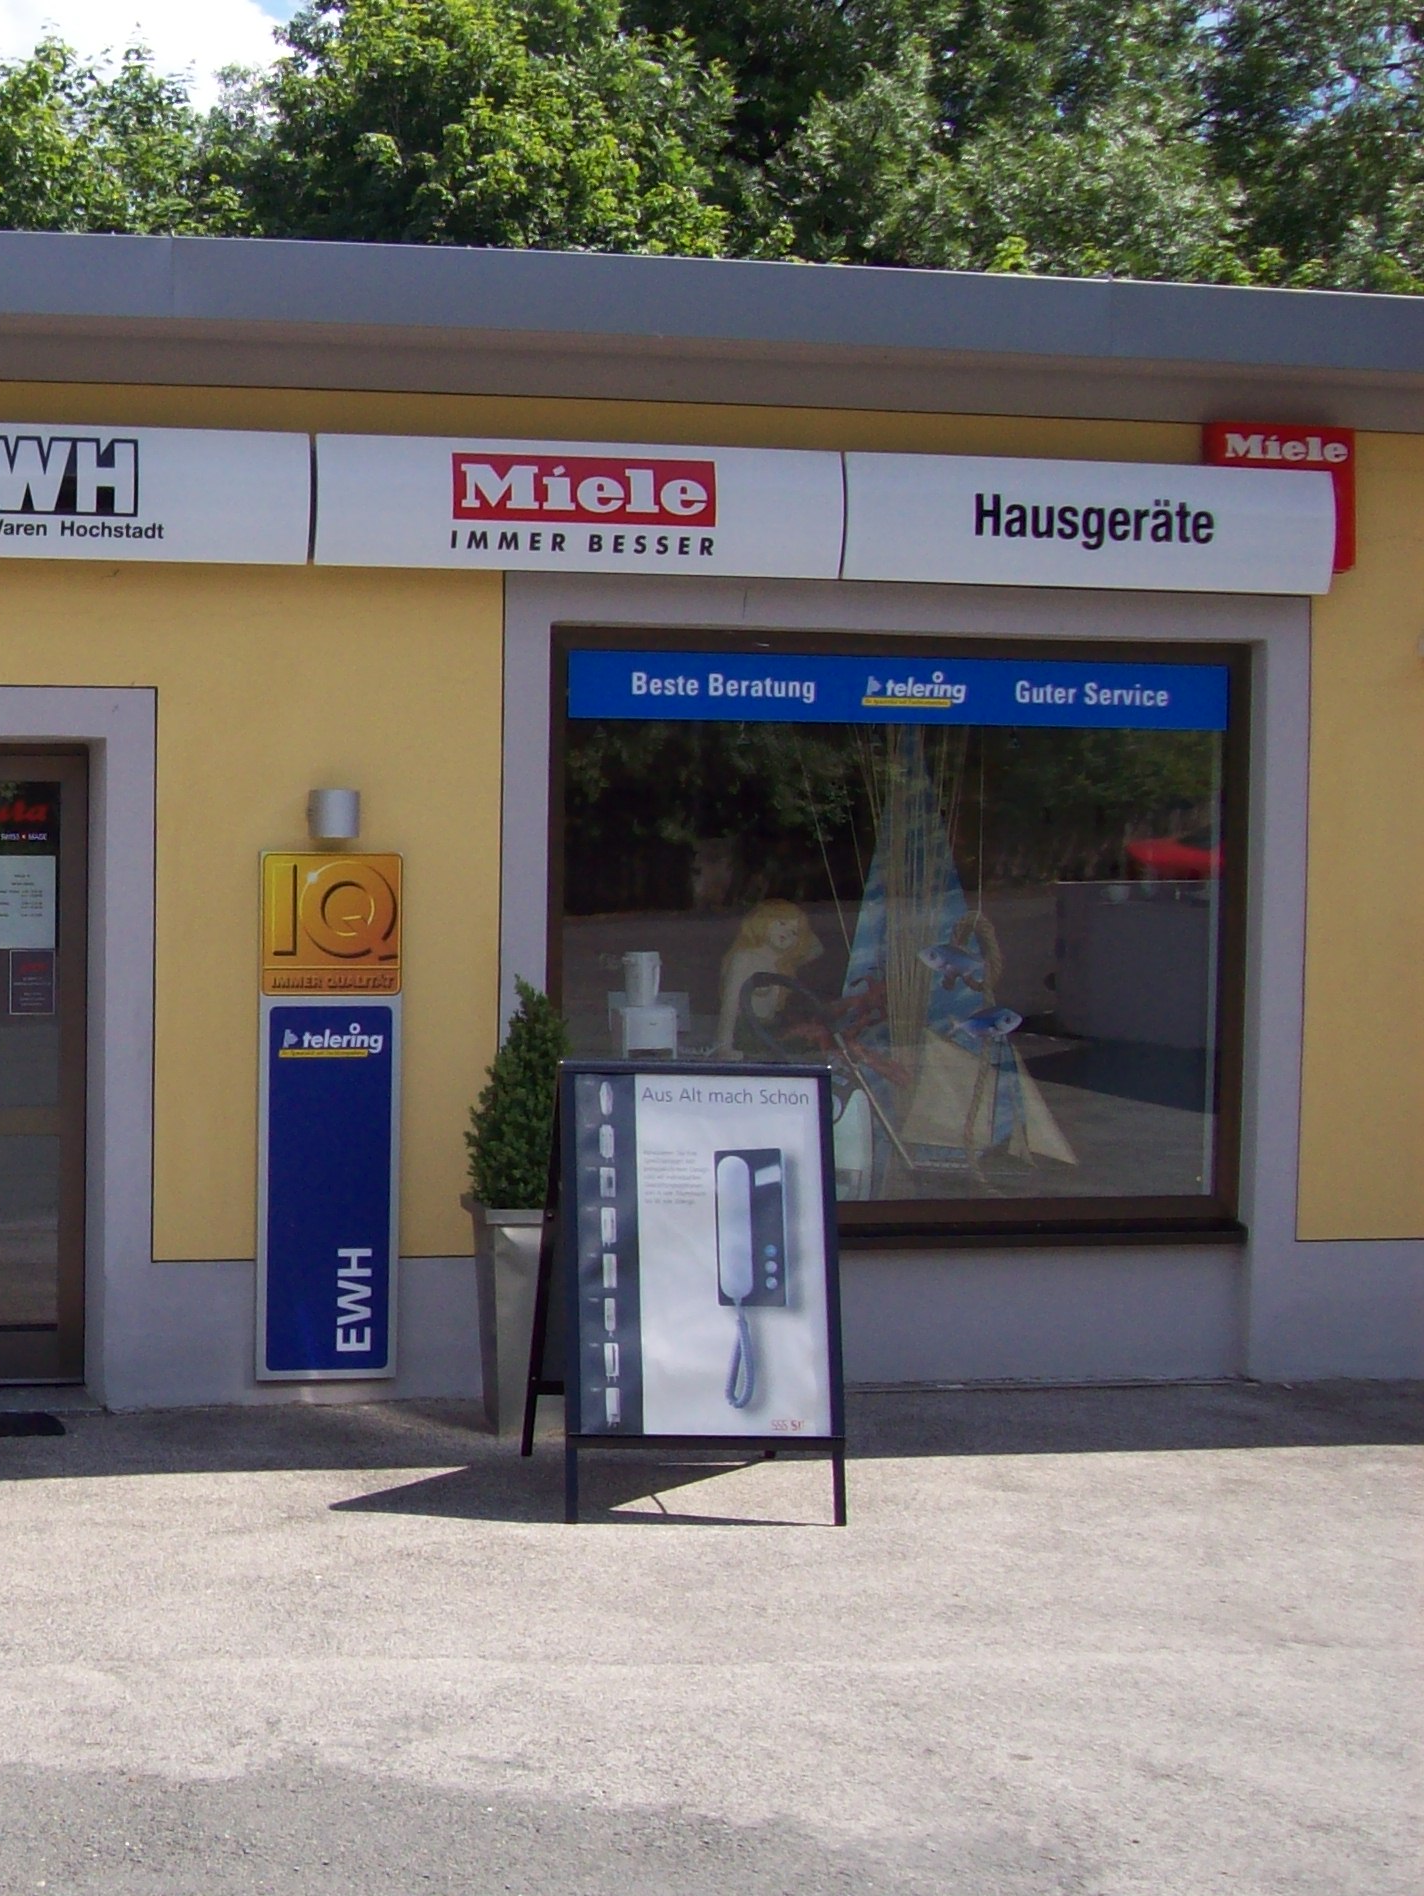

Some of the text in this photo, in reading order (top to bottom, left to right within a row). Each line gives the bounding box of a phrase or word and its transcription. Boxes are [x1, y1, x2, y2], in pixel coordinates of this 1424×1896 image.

[1224, 432, 1349, 464] Miele
[460, 462, 709, 517] Miele
[59, 520, 165, 540] Hochstadt
[974, 493, 1215, 551] Hausgeräte
[450, 529, 715, 557] IMMER BESSER
[631, 671, 816, 705] Beste Beratung
[885, 671, 967, 704] telering
[1015, 679, 1169, 708] Guter Service
[272, 860, 399, 961] IQ
[271, 975, 323, 990] IMMER
[302, 1022, 384, 1054] telering
[641, 1087, 673, 1103] Aus
[679, 1087, 703, 1104] Alt
[708, 1088, 753, 1105] mach
[336, 1248, 373, 1352] EWH
